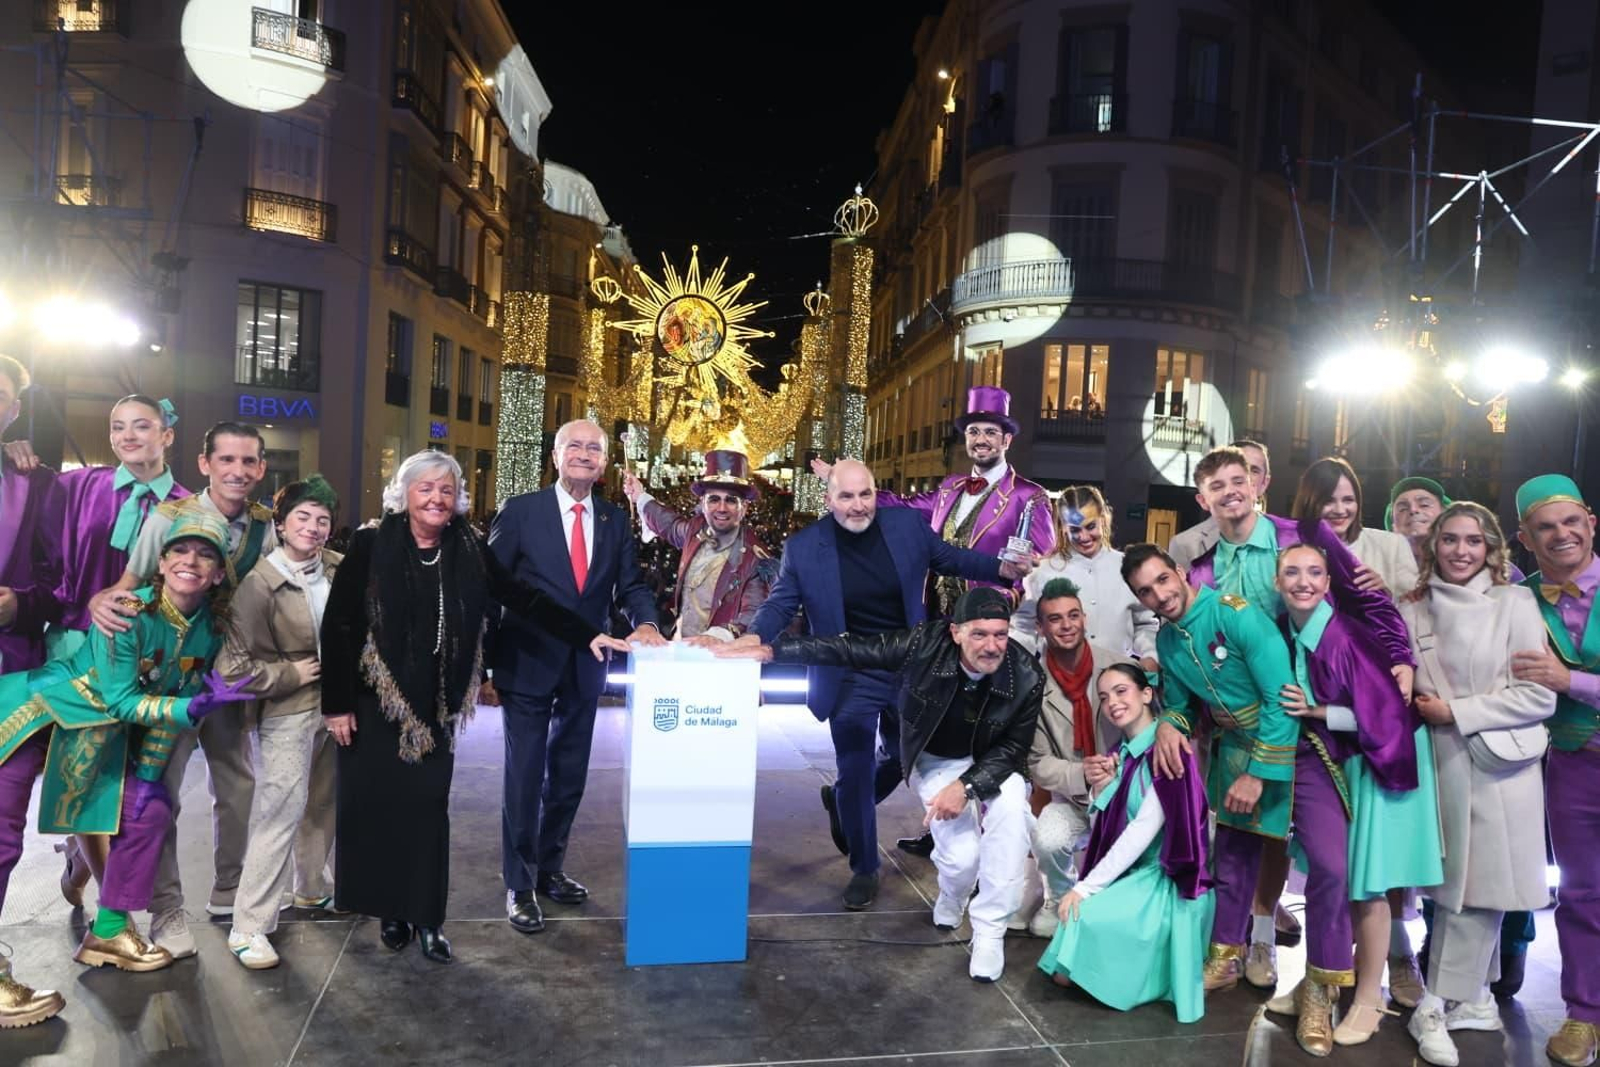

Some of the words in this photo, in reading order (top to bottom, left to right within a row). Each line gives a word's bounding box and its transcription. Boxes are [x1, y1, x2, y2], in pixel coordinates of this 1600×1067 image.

[239, 394, 314, 419] BBVA
[685, 704, 722, 715] Ciudad
[685, 717, 698, 726] de
